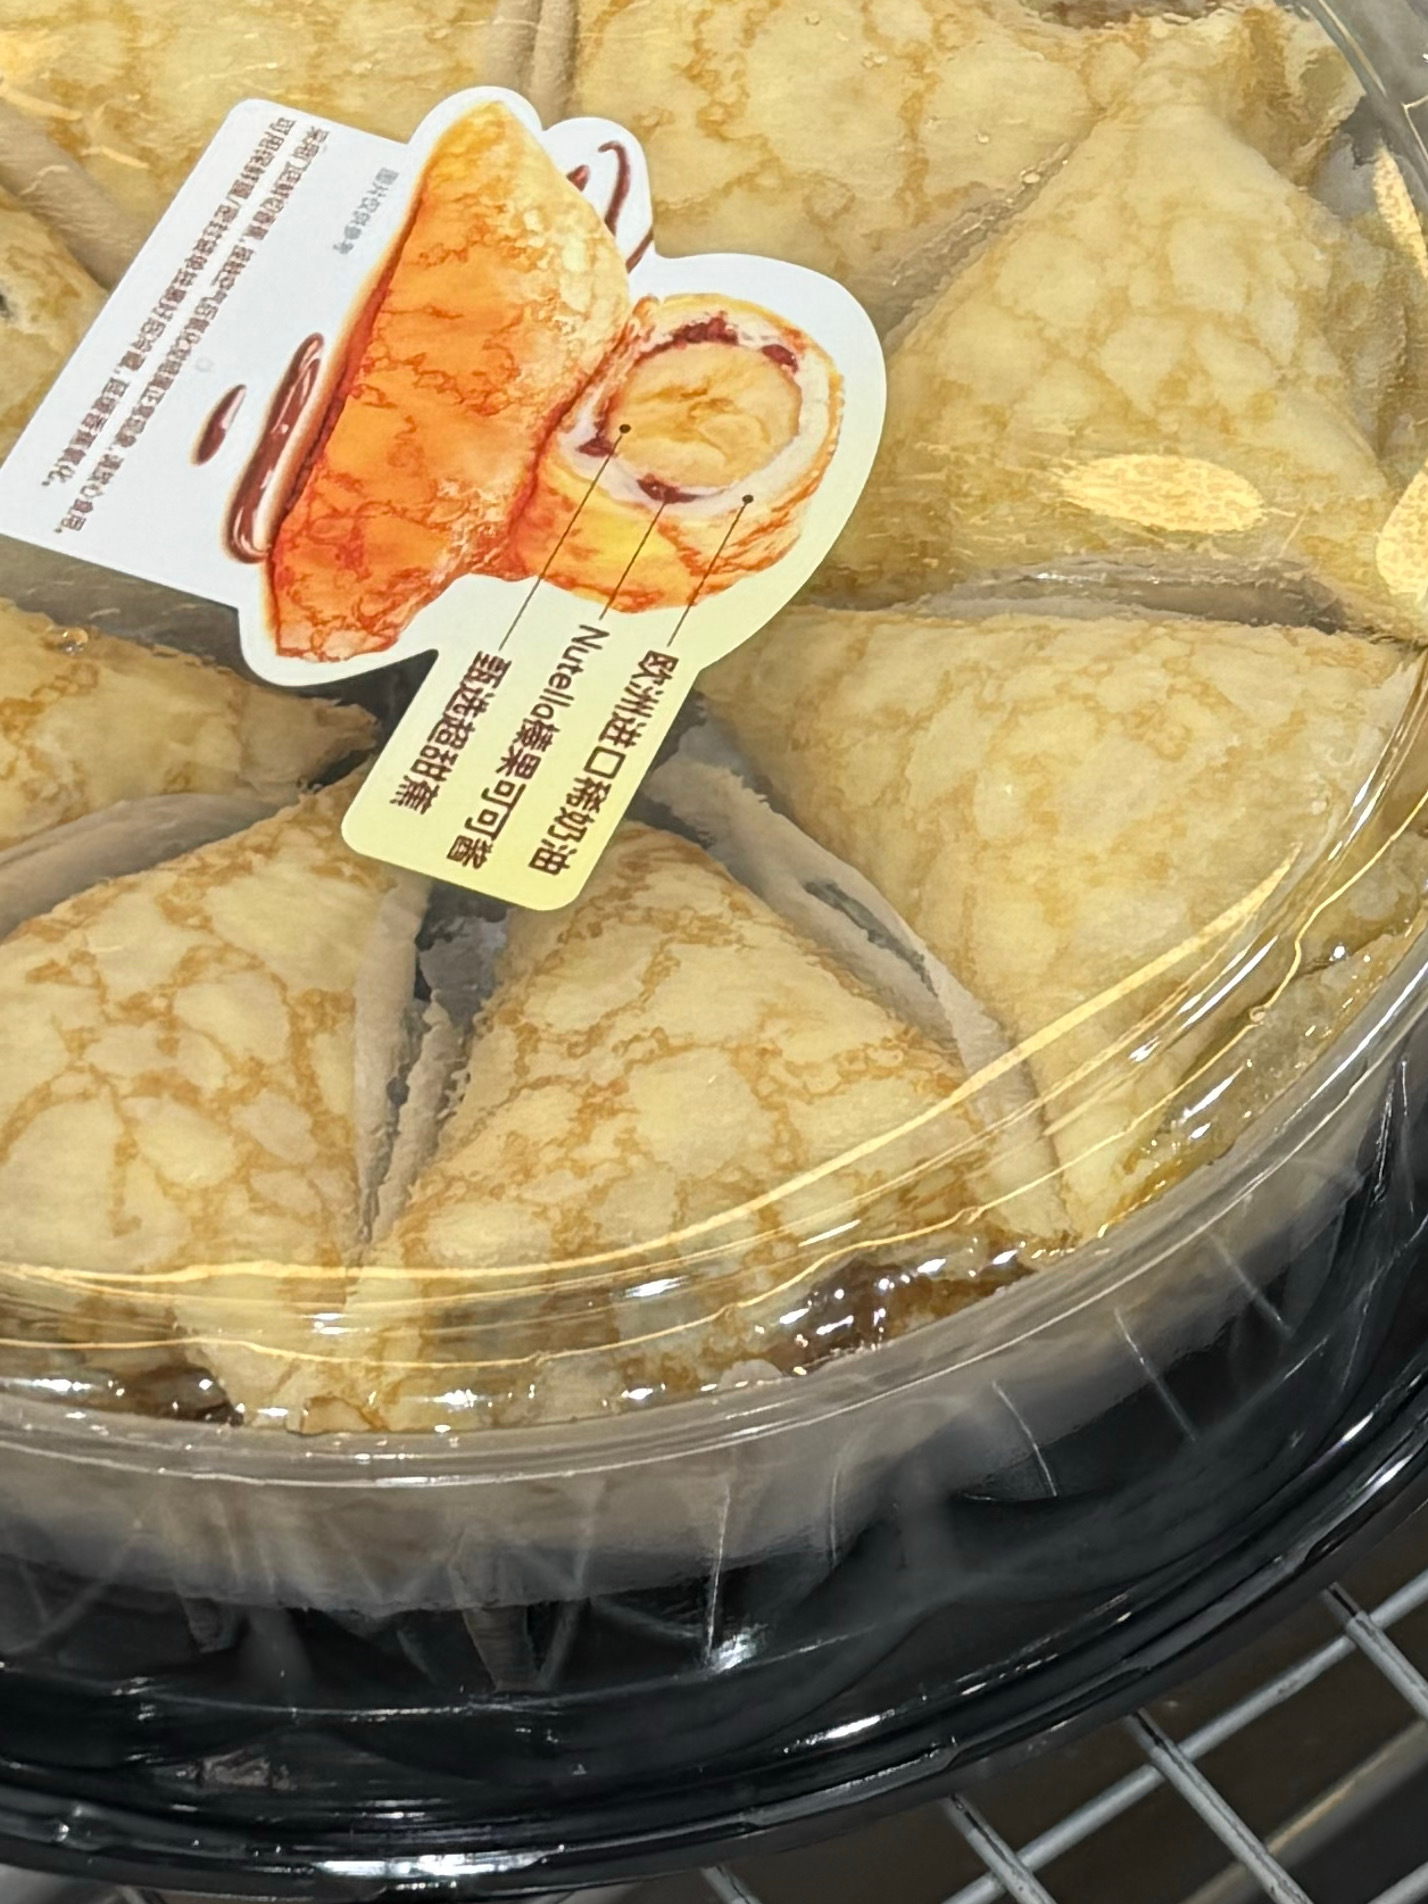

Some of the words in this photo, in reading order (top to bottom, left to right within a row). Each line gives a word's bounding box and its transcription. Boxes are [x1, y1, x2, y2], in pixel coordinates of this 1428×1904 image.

[388, 649, 512, 815] 甄选超甜蕉
[527, 649, 680, 876] 欧洲进口稀奶油
